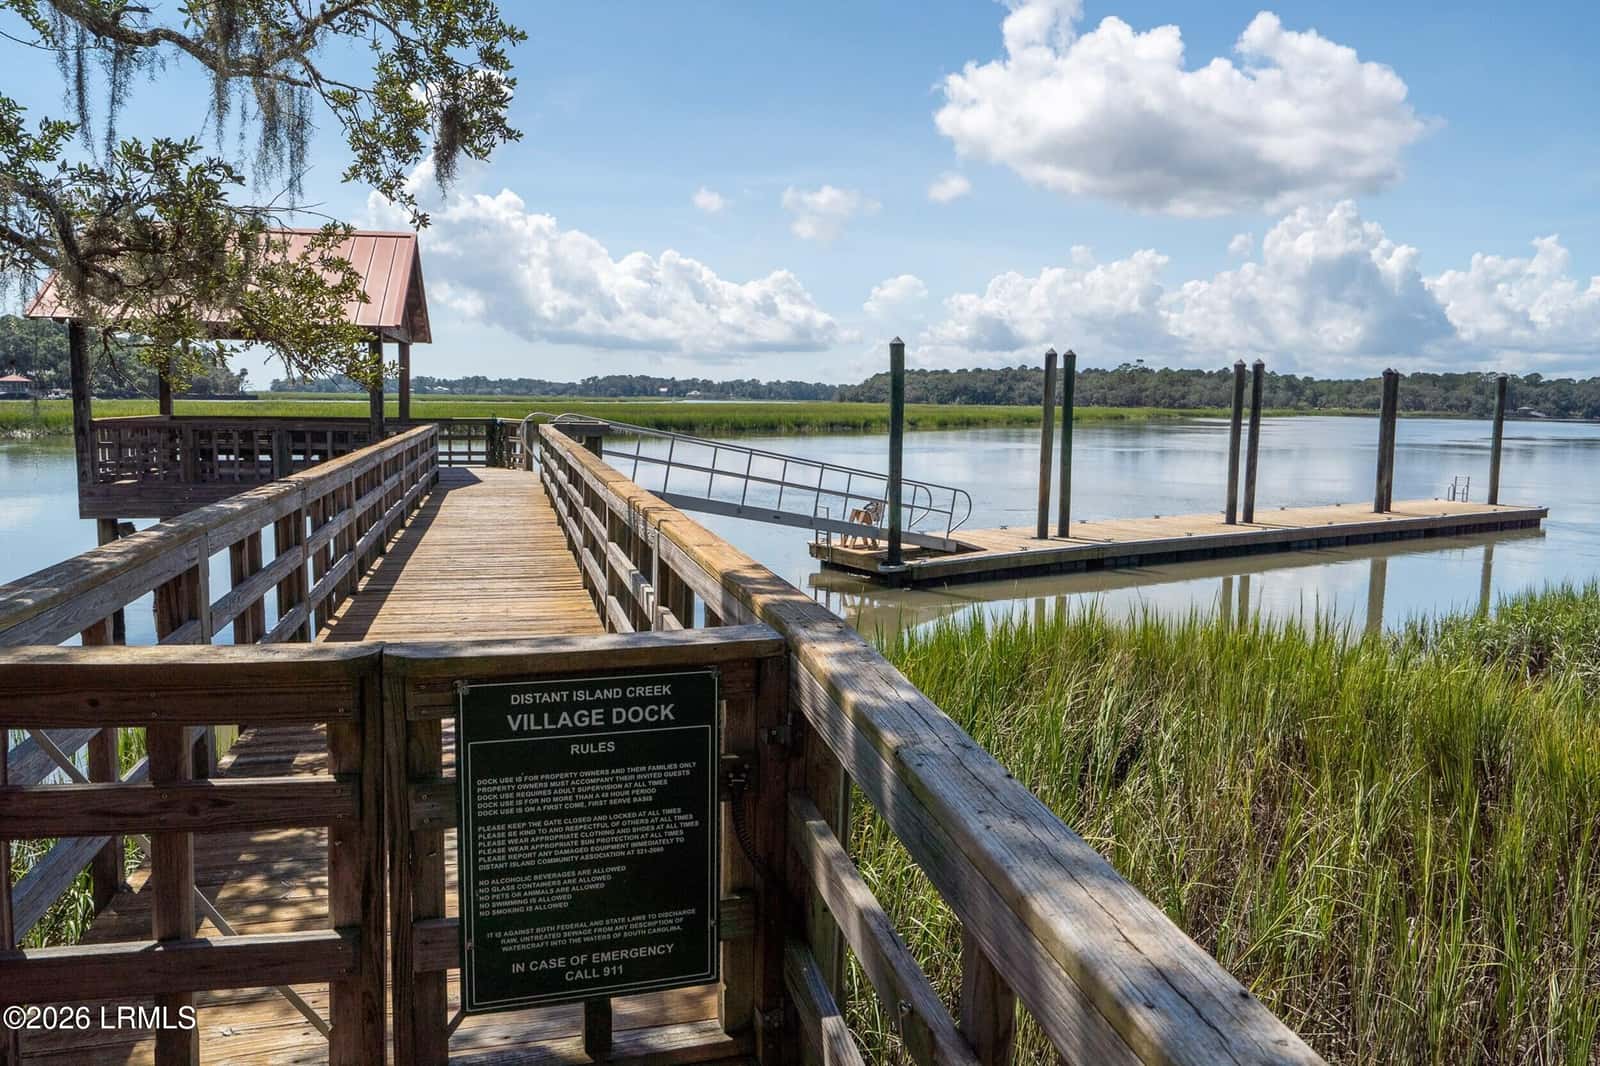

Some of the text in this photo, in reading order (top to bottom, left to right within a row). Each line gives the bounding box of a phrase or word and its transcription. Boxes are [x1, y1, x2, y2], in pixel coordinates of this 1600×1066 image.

[511, 684, 671, 705] DISTANT ISLAND CREEK
[507, 704, 675, 731] VILLAGE DOCK
[570, 741, 615, 755] RULES
[491, 875, 531, 885] ALCOHOLIC
[533, 870, 576, 880] BEVERAGES
[592, 865, 626, 874] ALLOWED
[491, 884, 515, 892] GLASS
[516, 879, 561, 890] CONTAINERS
[578, 874, 612, 884] ALLOWED
[491, 892, 510, 900] PETS
[523, 887, 554, 896] ANIMALS
[571, 882, 605, 891] ALLOWED
[491, 898, 528, 908] SWIMMING
[538, 894, 573, 903] ALLOWED
[491, 906, 524, 915] SMOKING
[534, 902, 569, 911] ALLOWED
[512, 943, 674, 973] IN CASE OF EMERGENCY
[565, 964, 623, 981] CALL 911
